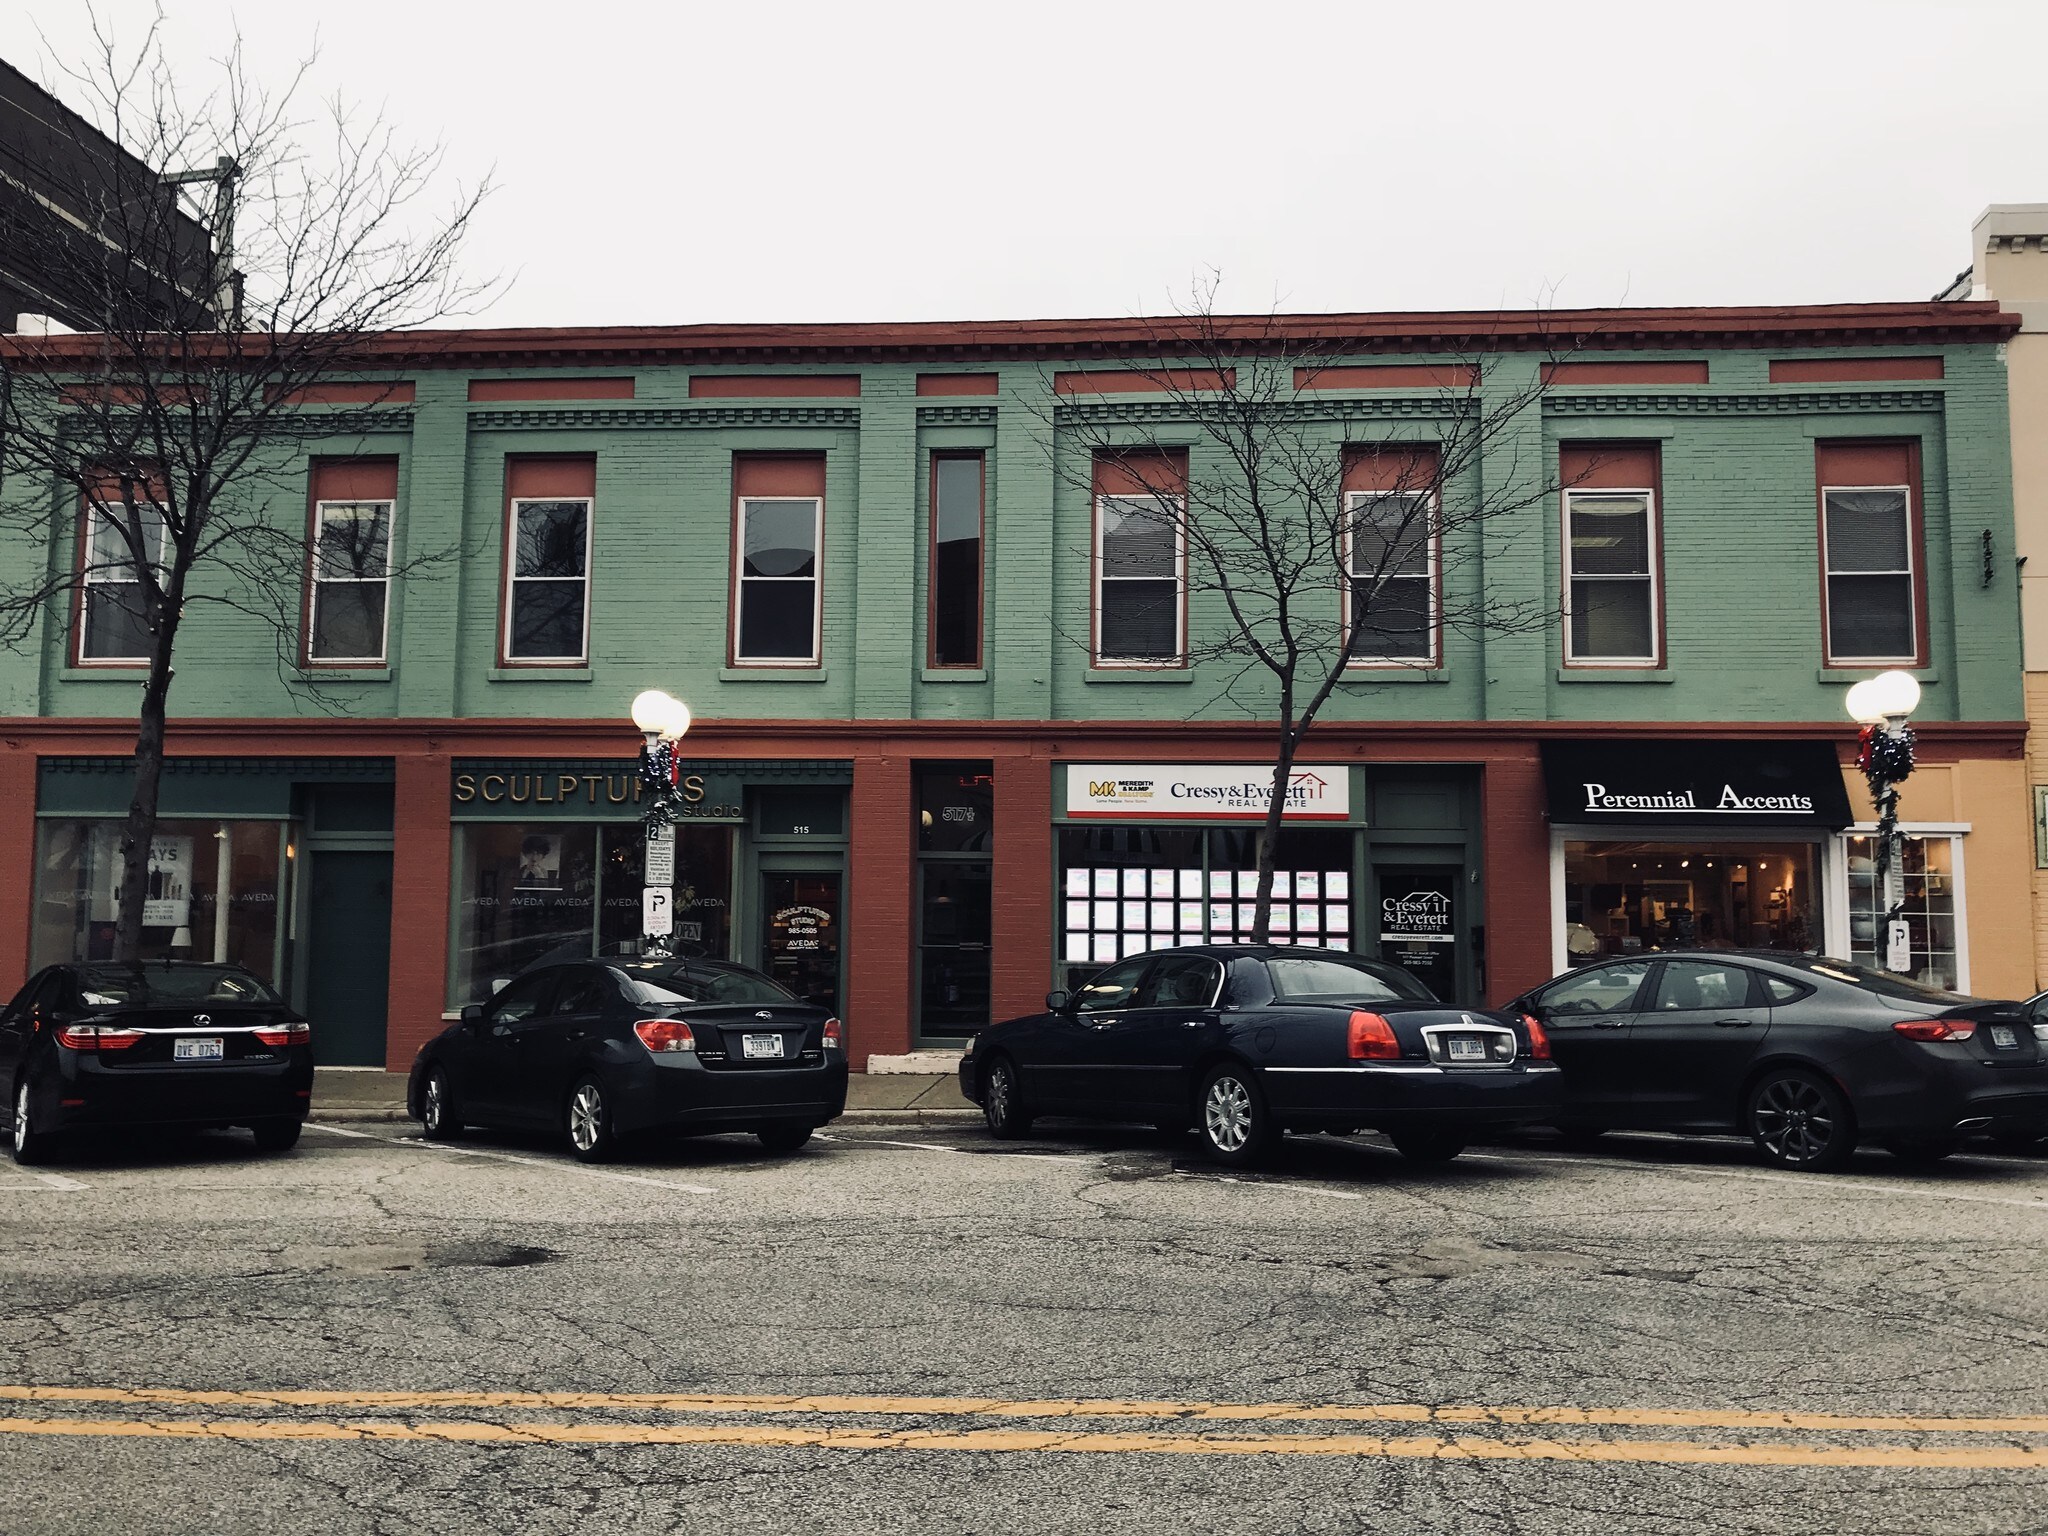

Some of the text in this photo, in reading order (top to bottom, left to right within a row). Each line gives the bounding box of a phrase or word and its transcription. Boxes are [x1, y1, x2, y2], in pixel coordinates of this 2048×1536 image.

[455, 774, 705, 802] SCULPTUS
[1171, 782, 1306, 804] Cressy&Eveett
[1582, 783, 1813, 809] Perennial Accents
[1228, 799, 1258, 807] REAL
[683, 803, 741, 817] studio
[650, 826, 658, 839] 2
[793, 826, 810, 834] 515
[150, 849, 178, 862] AYS
[242, 893, 275, 902] AVEDA
[512, 897, 544, 906] AVEDA
[554, 898, 590, 906] AVEDA
[605, 898, 640, 906] AVEDA
[691, 898, 725, 907] AVEDA
[1382, 897, 1431, 916] Cressy
[776, 906, 830, 921] SCULPTURES
[790, 916, 816, 926] STUDIO
[676, 923, 701, 939] OPEN
